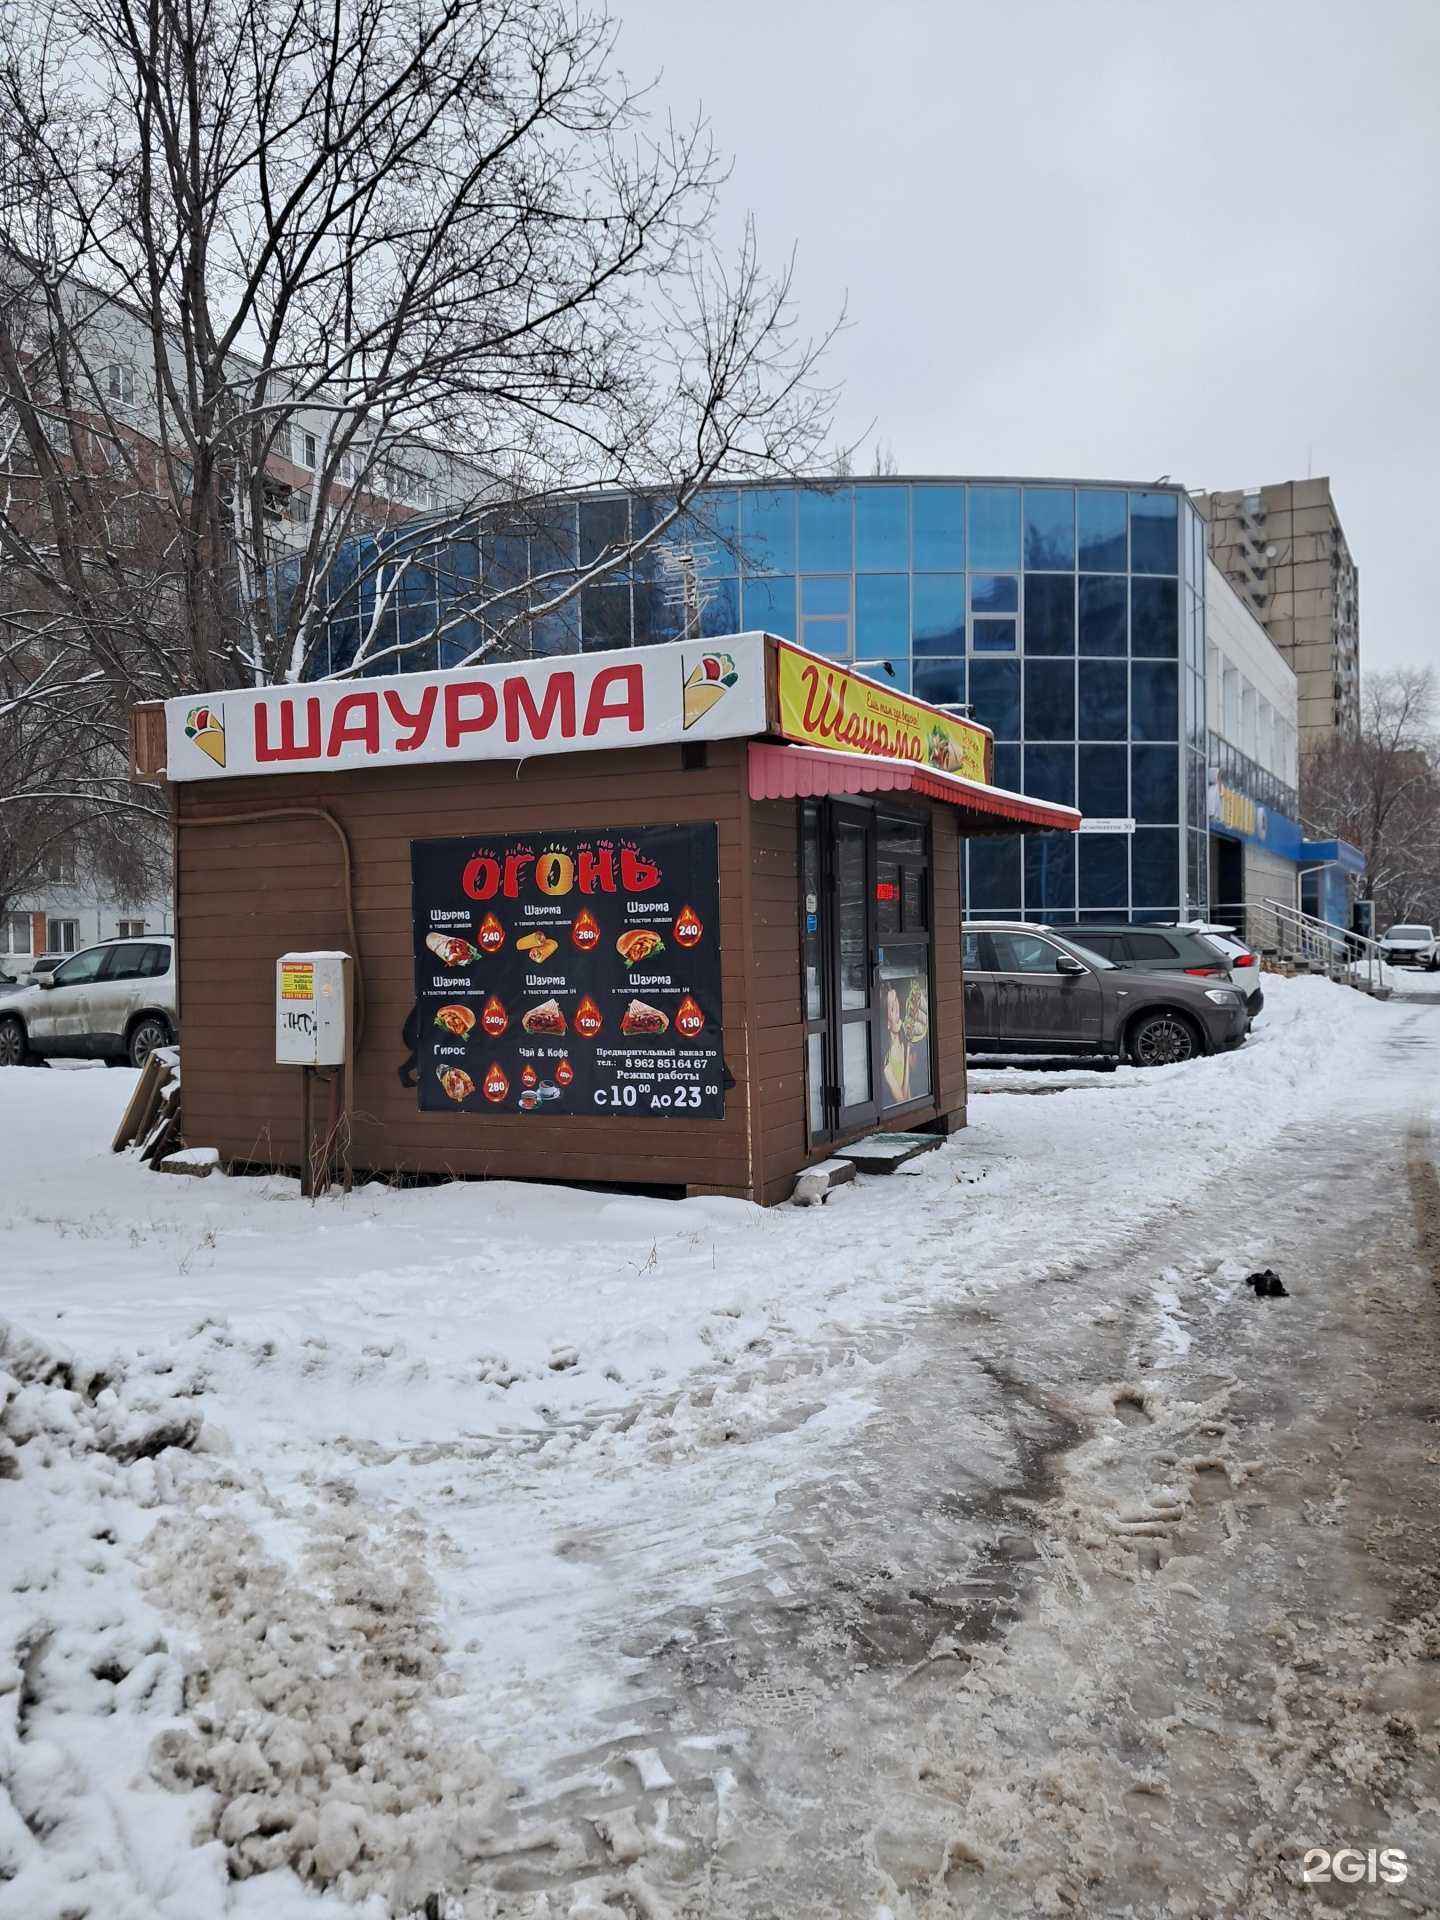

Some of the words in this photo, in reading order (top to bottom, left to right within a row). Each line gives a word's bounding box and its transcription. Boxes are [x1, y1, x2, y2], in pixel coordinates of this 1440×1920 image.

[254, 663, 645, 763] ШАУРМА
[524, 904, 562, 916] Шаурма
[626, 901, 670, 914] Шаурма
[430, 909, 471, 921] Шаурма
[482, 931, 500, 942] 240
[679, 925, 698, 936] 240
[432, 976, 471, 987] Шаурма
[525, 974, 566, 986] Шаурма
[629, 973, 672, 985] Шаурма
[433, 1044, 466, 1056] Гирос
[518, 1047, 535, 1057] Чай
[537, 1048, 545, 1057] &
[547, 1047, 569, 1058] Кофе
[596, 1048, 676, 1057] Предварительный
[625, 1059, 633, 1068] 8
[634, 1059, 655, 1068] 962
[693, 1060, 708, 1069] 67
[617, 1070, 655, 1080] Режим
[657, 1070, 700, 1082] работы
[487, 1081, 505, 1093] 280
